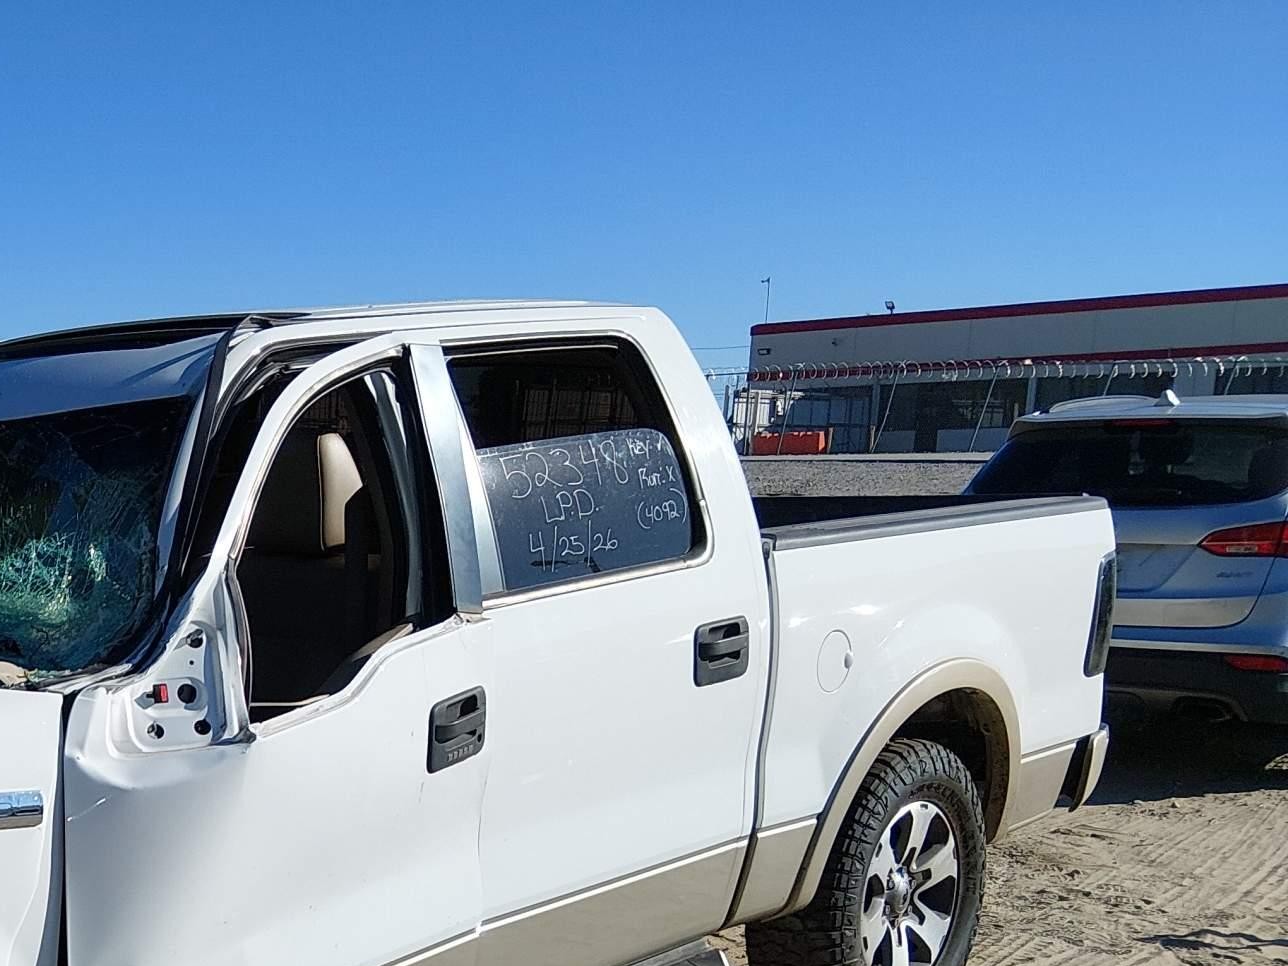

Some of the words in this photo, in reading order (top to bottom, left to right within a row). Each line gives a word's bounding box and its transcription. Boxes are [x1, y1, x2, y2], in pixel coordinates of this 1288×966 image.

[498, 438, 629, 498] 52348
[637, 487, 687, 529] (4092)
[529, 519, 618, 573] 4/25/26
